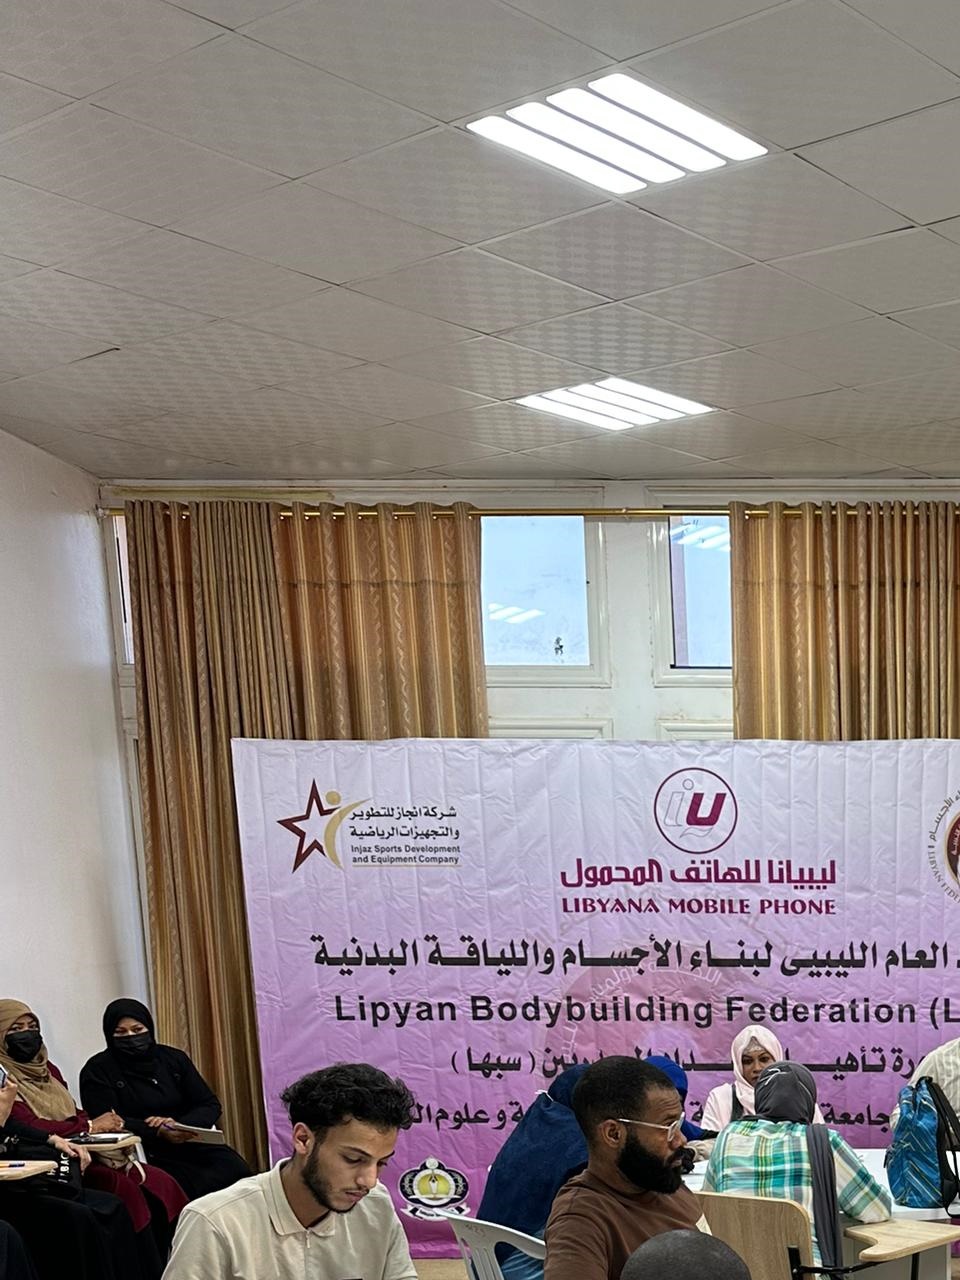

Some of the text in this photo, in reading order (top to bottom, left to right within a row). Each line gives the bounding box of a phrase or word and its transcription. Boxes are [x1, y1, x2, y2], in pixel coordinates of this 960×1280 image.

[349, 806, 395, 821] للتطوير
[423, 805, 457, 821] شركة
[349, 826, 460, 840] والتجهيزات الرياضية
[351, 845, 461, 855] Injaz Sports Development
[352, 855, 460, 865] and Equipment Company
[560, 858, 837, 890] ليبيانا للهاتف المحمول
[562, 897, 837, 915] LIBYANA MOBILE PHONE
[310, 934, 419, 977] البدنية
[424, 933, 555, 977] واللياقة
[562, 933, 682, 976] الأجسام
[690, 939, 773, 977] لبناء
[885, 940, 949, 978] العام
[336, 995, 457, 1027] Lipyan
[472, 995, 712, 1028] Bodybuilding
[726, 996, 916, 1023] Federation
